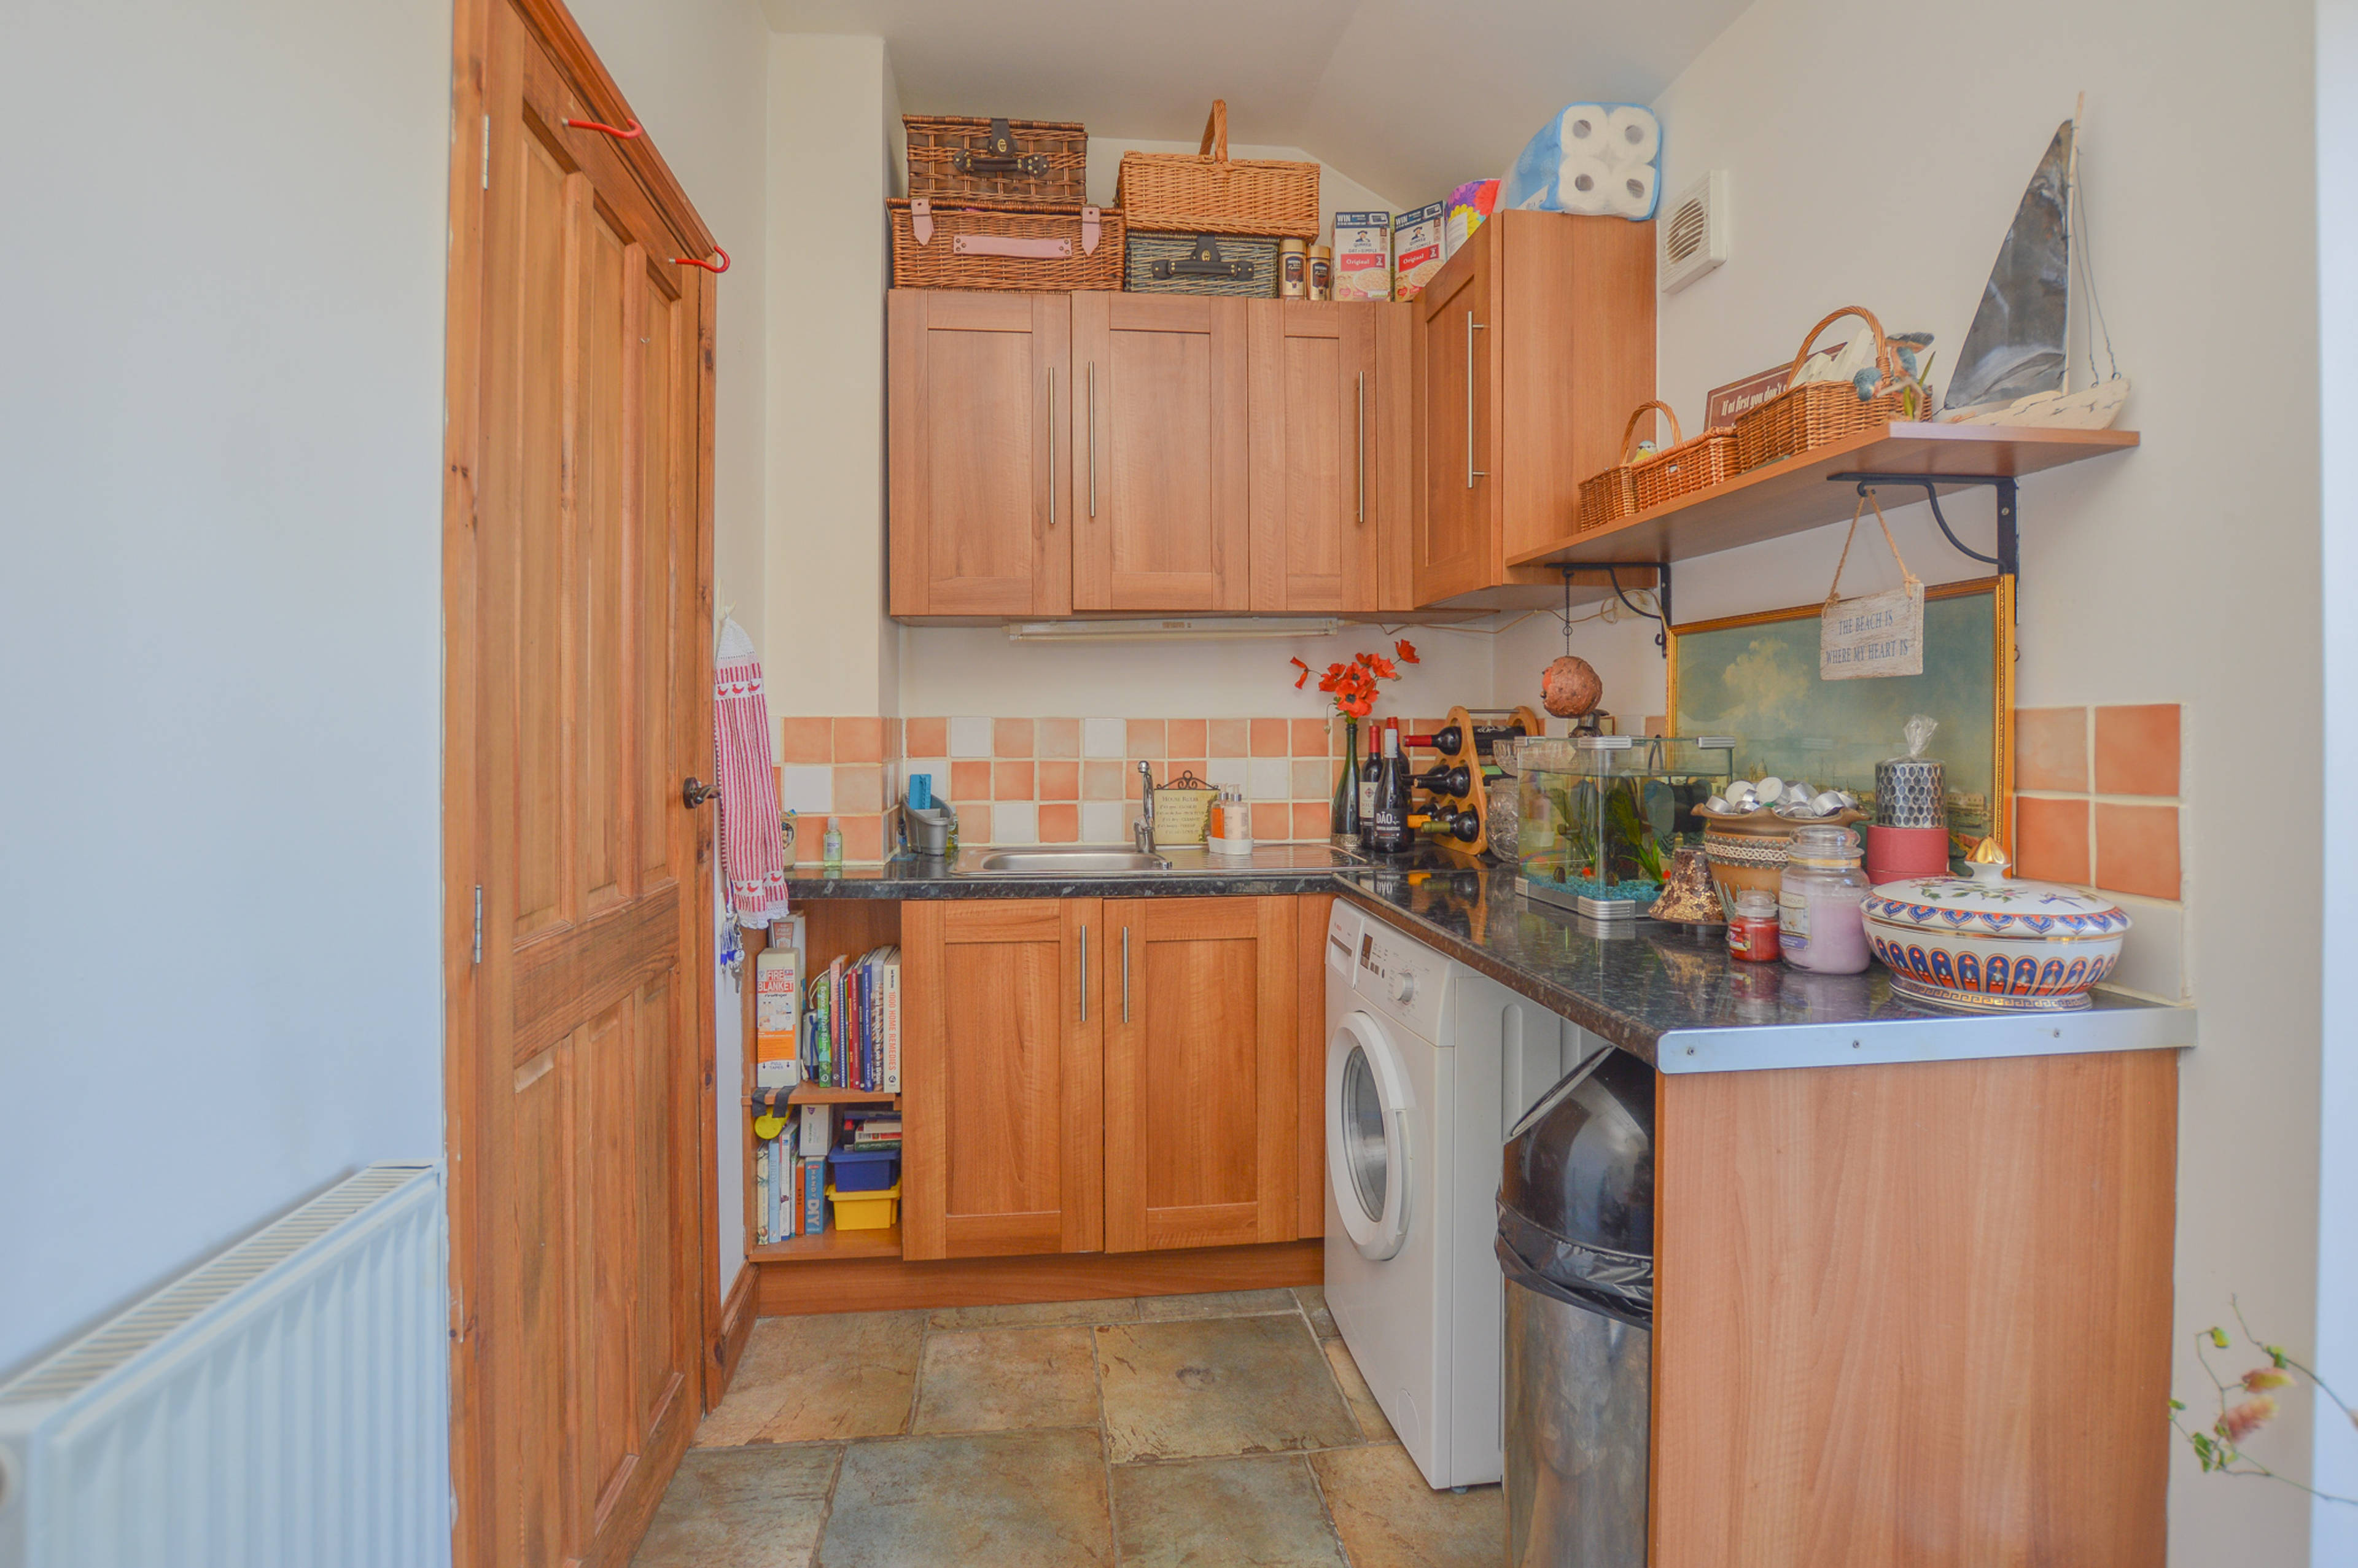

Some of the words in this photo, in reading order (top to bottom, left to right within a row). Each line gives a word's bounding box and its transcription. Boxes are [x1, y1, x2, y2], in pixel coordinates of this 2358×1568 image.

[1396, 215, 1408, 225] WIN
[1403, 254, 1424, 264] Original
[1735, 395, 1750, 413] first
[1839, 619, 1853, 635] THE
[1856, 613, 1881, 632] BEACH
[1885, 609, 1893, 626] IS
[1826, 648, 1851, 664] WHERE
[1854, 645, 1865, 661] MY
[1868, 640, 1896, 659] HEART
[1899, 638, 1908, 656] IS
[1376, 811, 1393, 825] DÃO
[768, 970, 784, 980] FIRE
[758, 982, 793, 992] BLANKET
[806, 1198, 820, 1226] DIY
